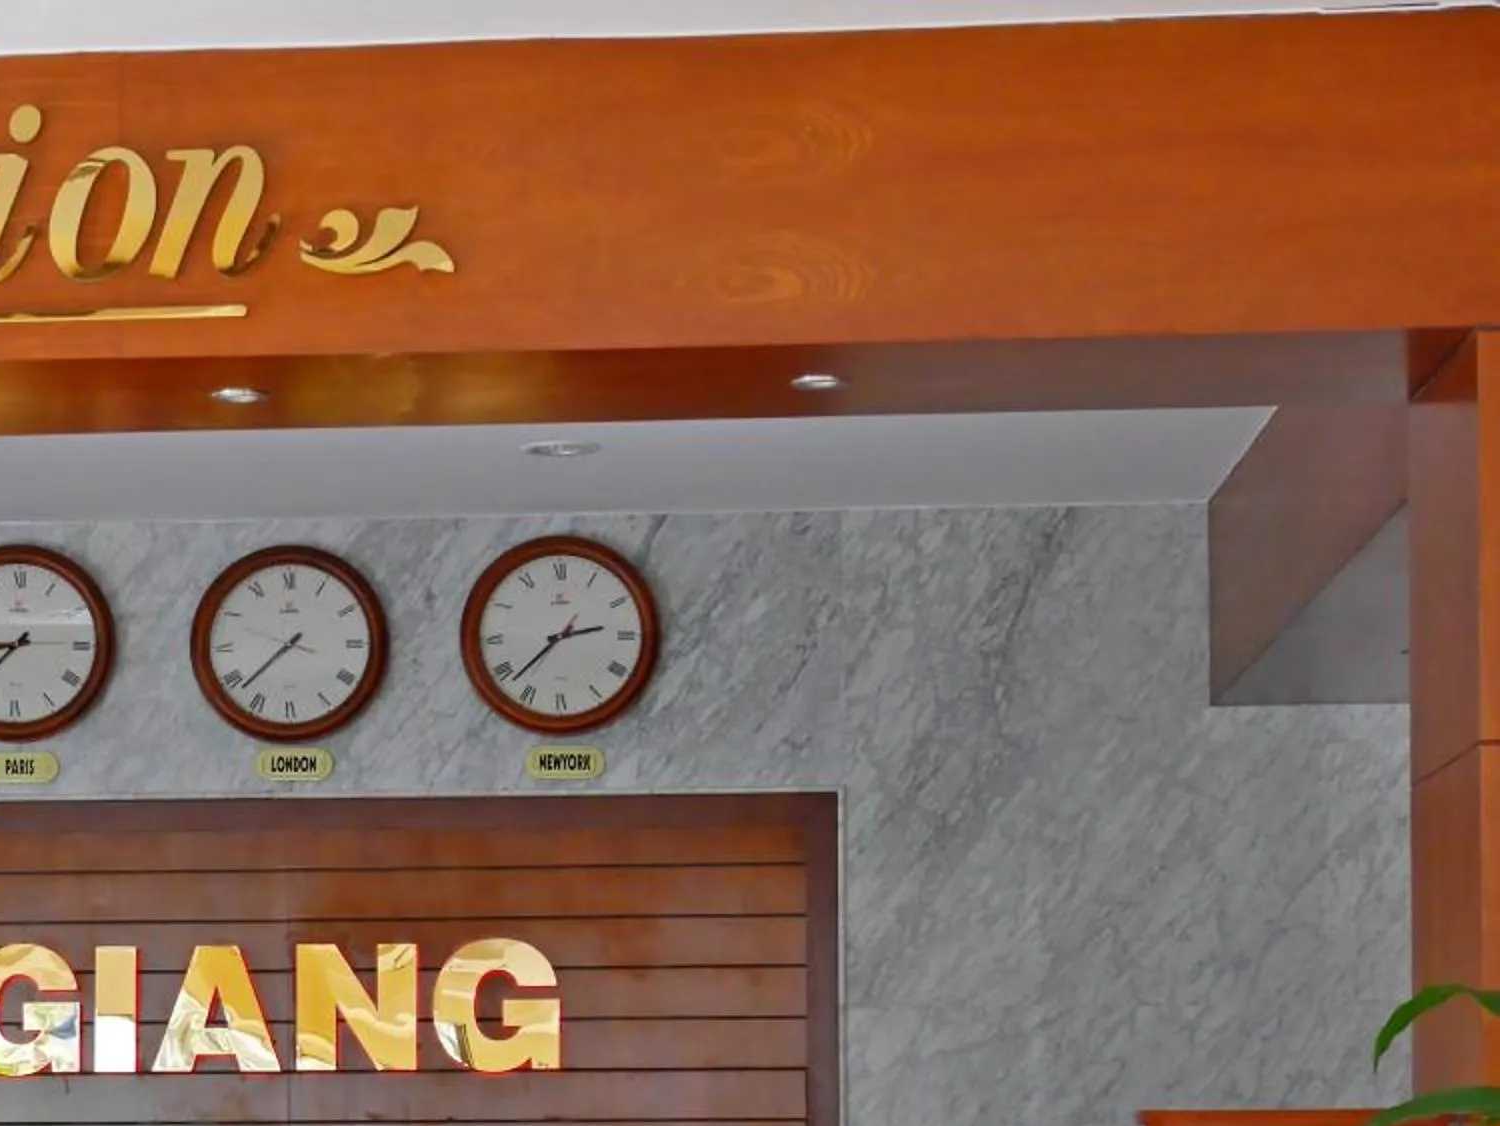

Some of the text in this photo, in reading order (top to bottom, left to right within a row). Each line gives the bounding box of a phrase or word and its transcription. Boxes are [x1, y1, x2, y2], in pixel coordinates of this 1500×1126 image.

[5, 759, 35, 775] PARIS
[271, 756, 317, 773] LONDON
[539, 753, 592, 771] NEWYORK
